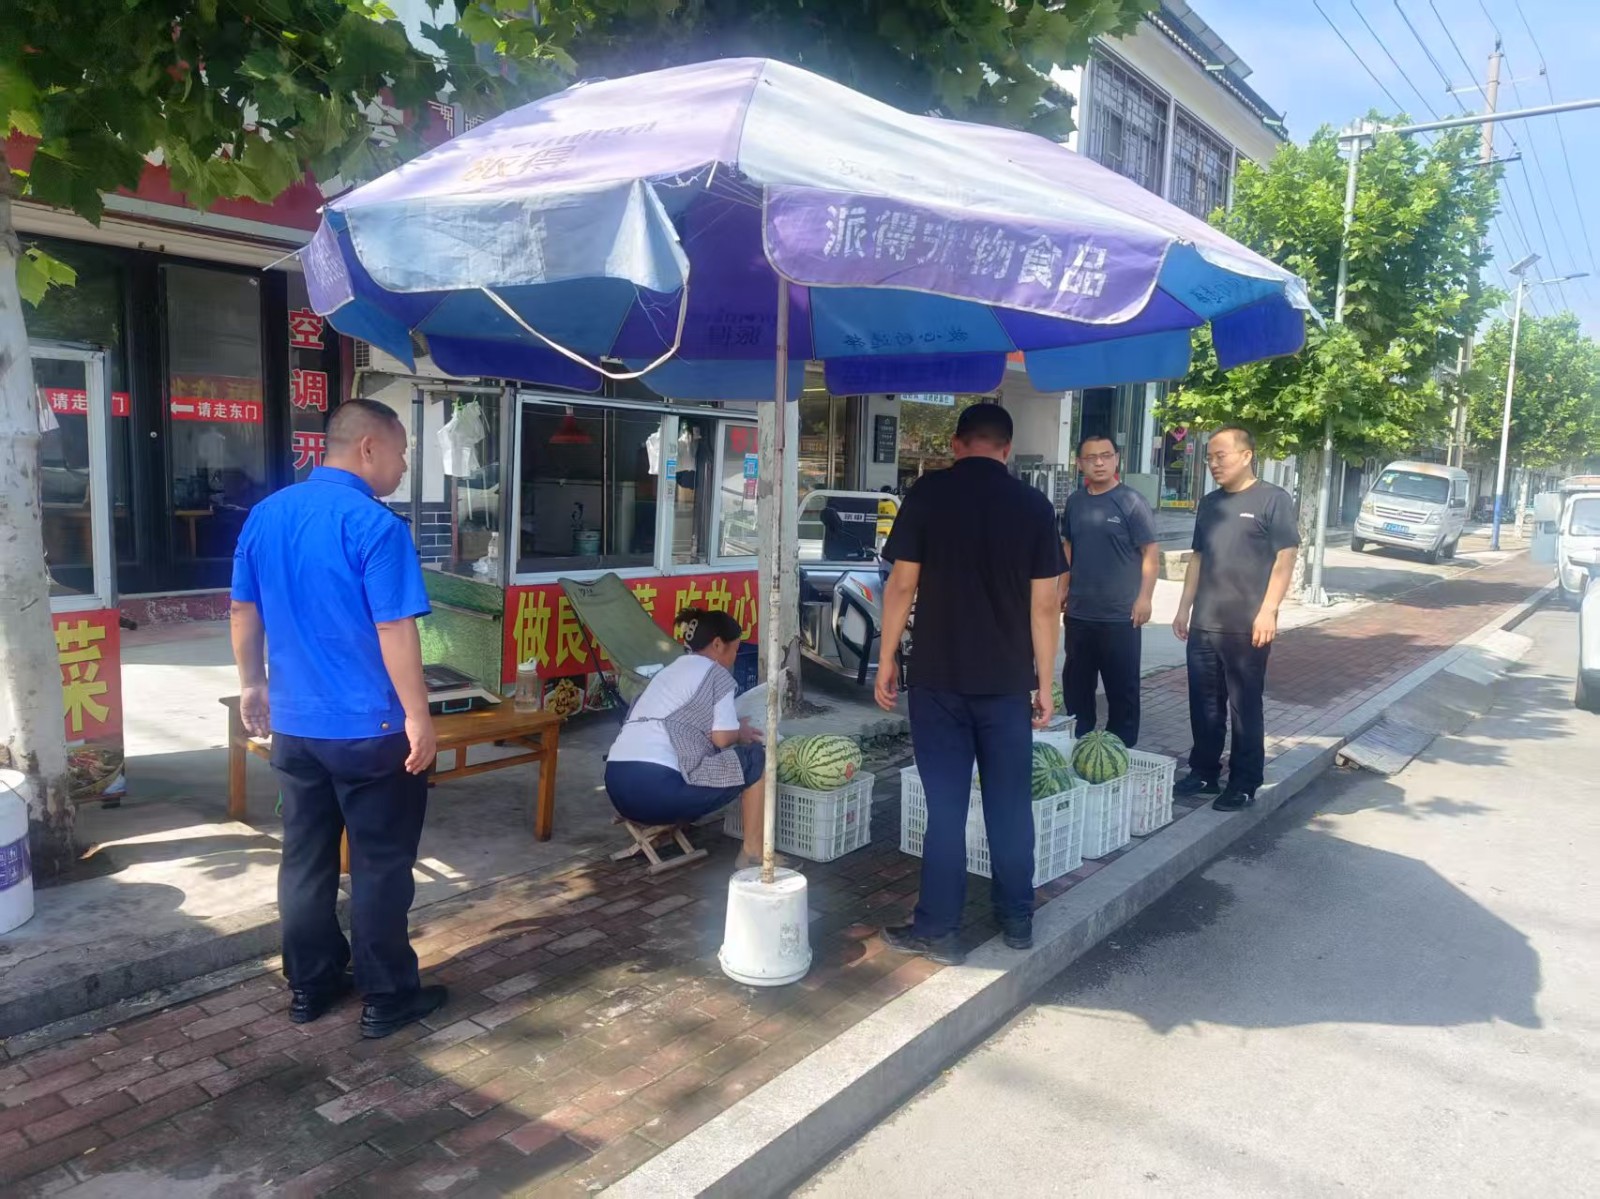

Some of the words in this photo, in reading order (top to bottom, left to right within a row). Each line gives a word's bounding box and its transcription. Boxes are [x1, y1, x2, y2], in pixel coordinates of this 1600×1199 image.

[52, 392, 124, 413] 请走门
[197, 401, 257, 420] 请走东门
[288, 307, 328, 470] 空调开
[54, 619, 110, 733] 菜
